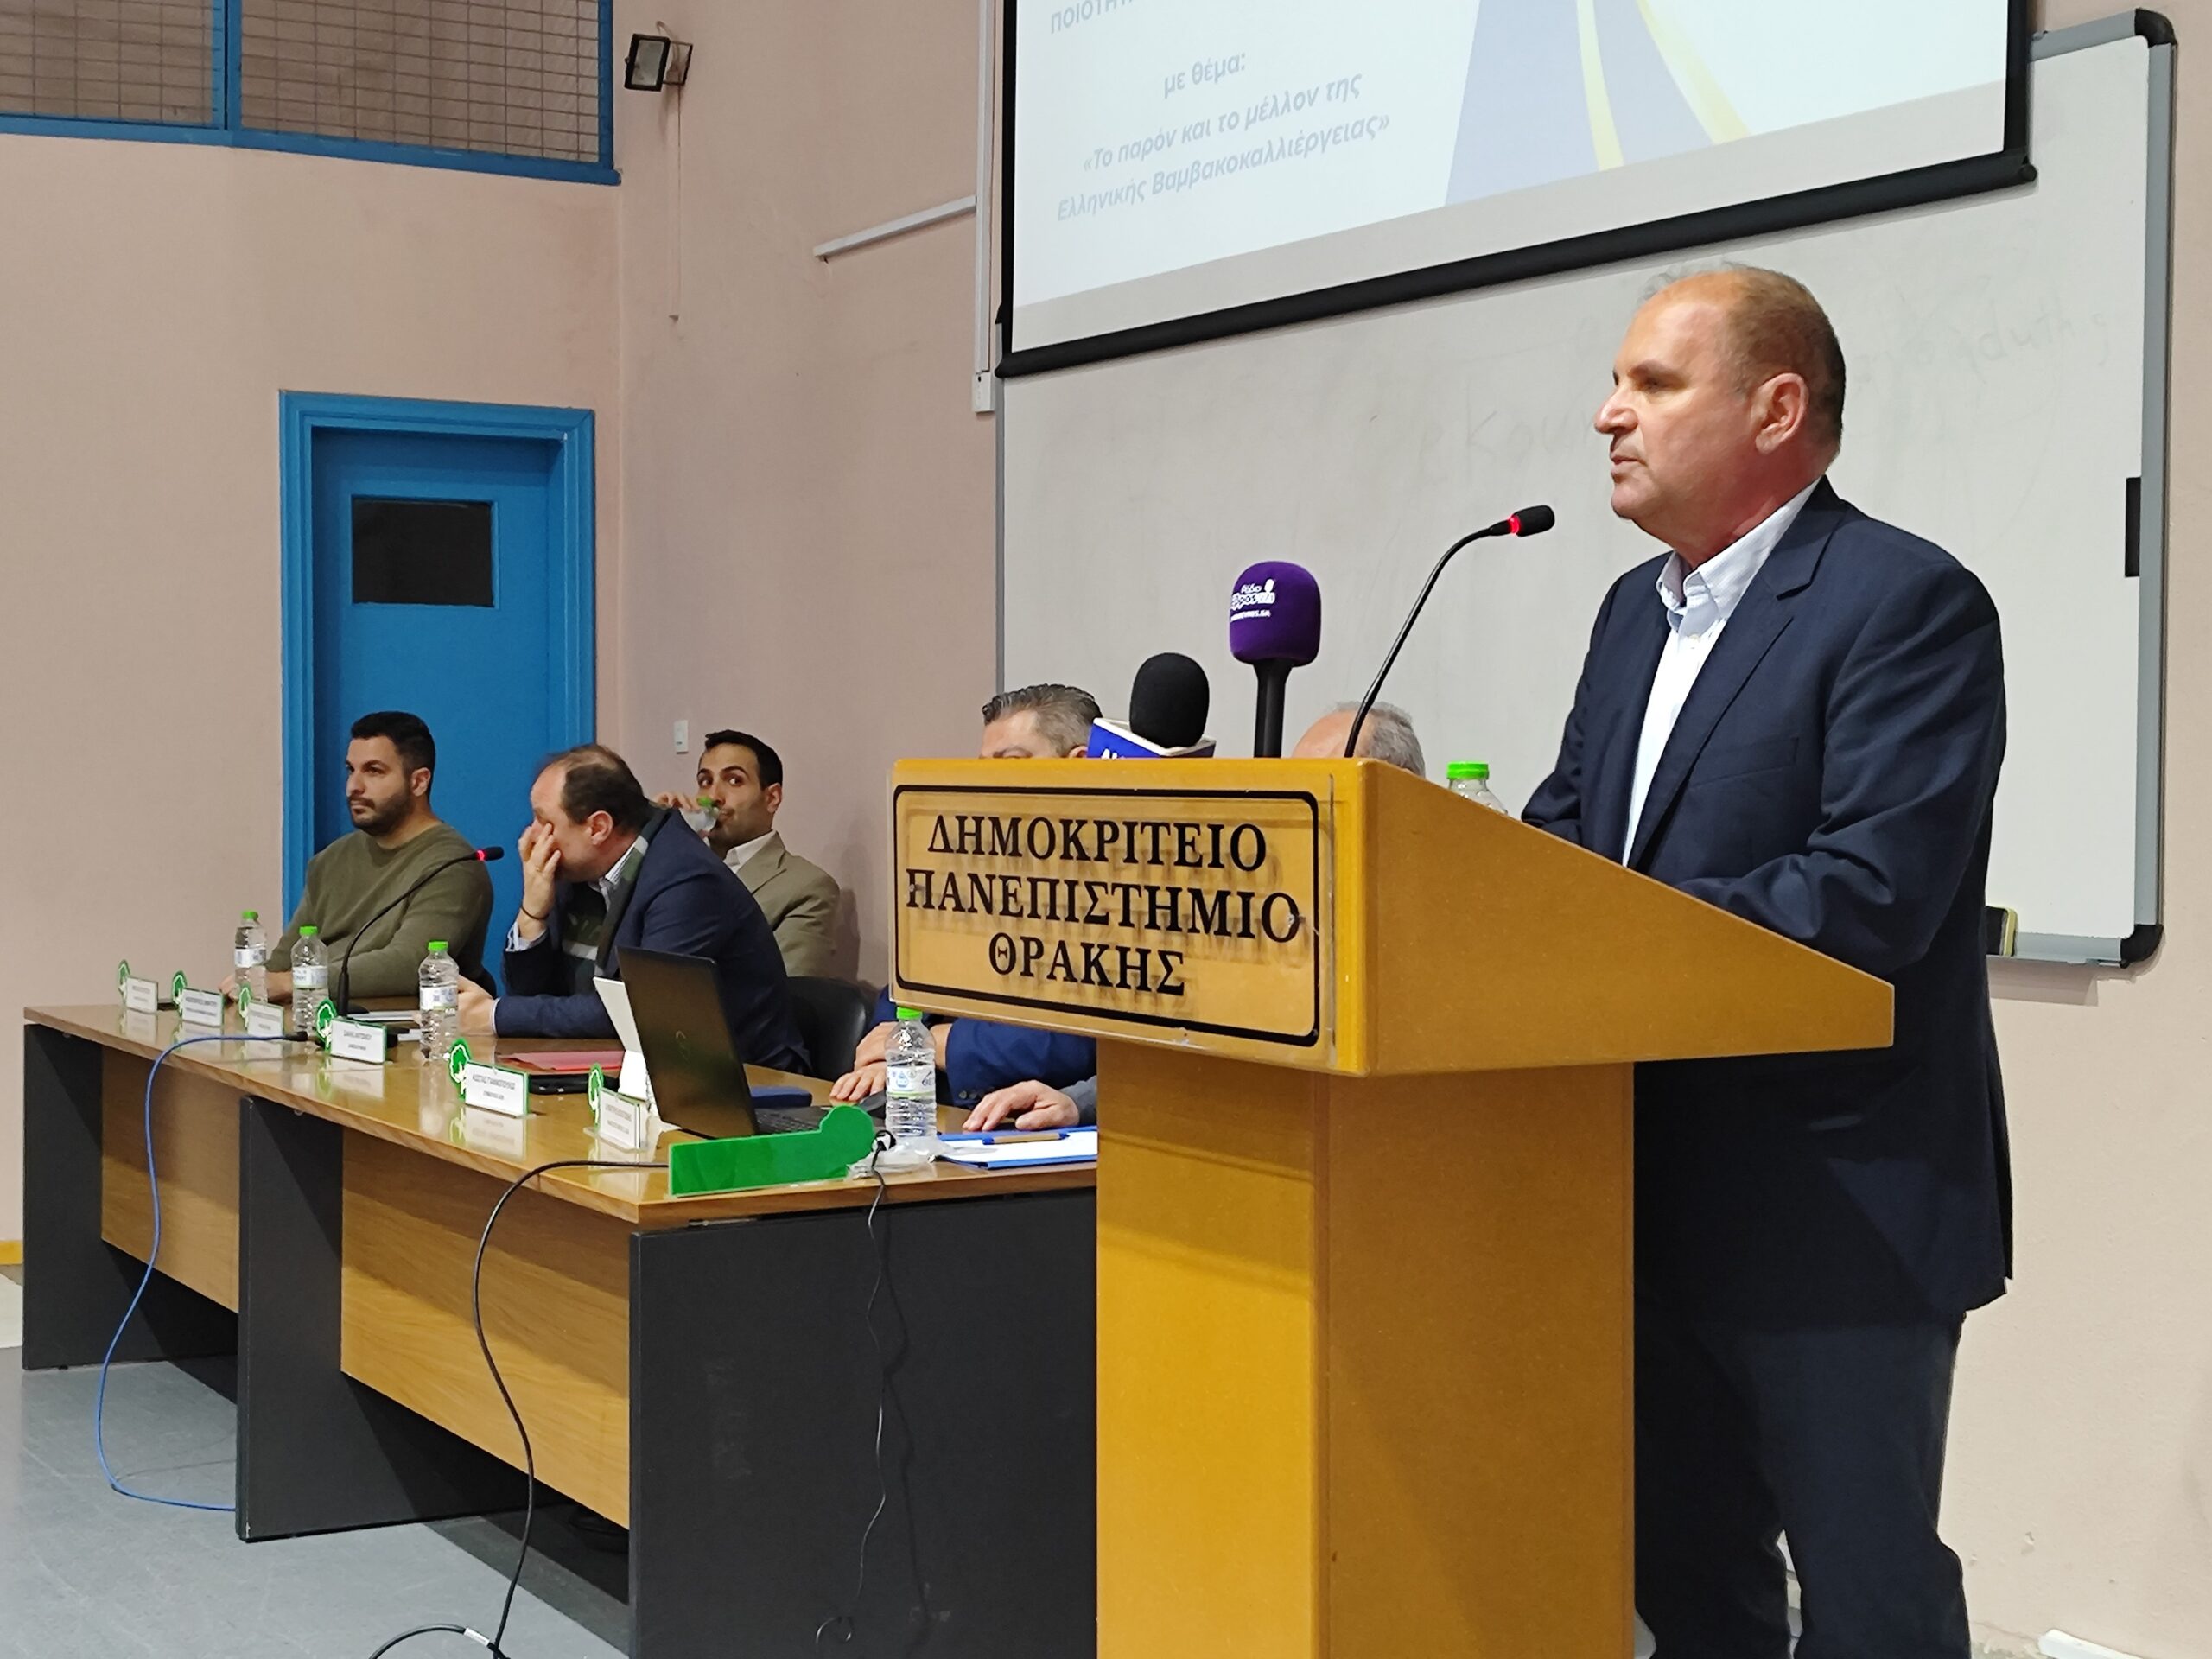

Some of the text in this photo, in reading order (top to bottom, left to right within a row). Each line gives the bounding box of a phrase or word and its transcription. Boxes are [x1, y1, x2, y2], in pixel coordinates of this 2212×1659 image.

[1164, 52, 1246, 99] με θέμα:
[1118, 127, 1178, 162] παρόν
[1181, 119, 1211, 143] και
[1217, 111, 1240, 133] το
[1243, 86, 1320, 131] μέλλον
[1325, 73, 1363, 103] της
[1057, 114, 1390, 221] Ελληνικής Βαμβακοκαλλιέργειας»
[927, 814, 1267, 873] ΔΗΜΟΚΡΙΤΕΙΟ
[906, 868, 1300, 944] ΠΑΝΕΠΙΣΤΗΜΙΟ
[988, 932, 1185, 996] ΘΡΑΚΗΣ
